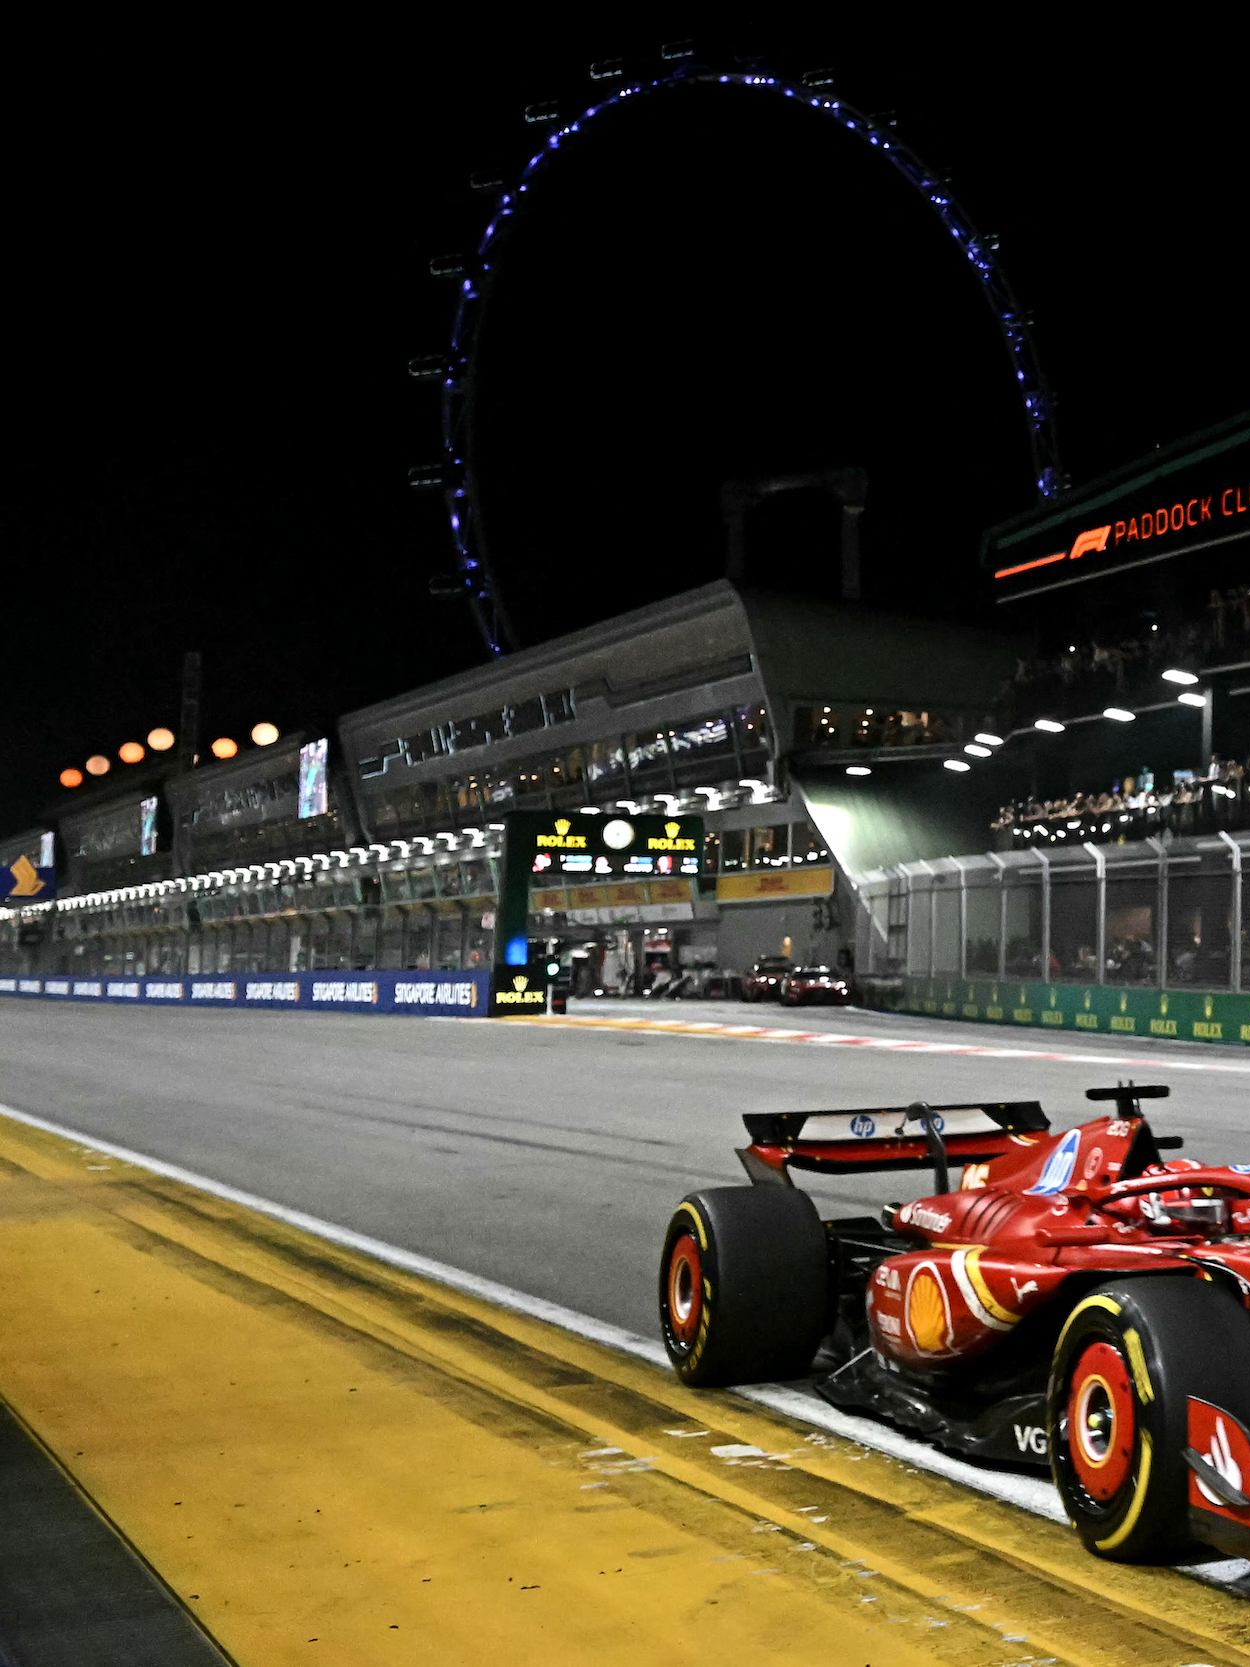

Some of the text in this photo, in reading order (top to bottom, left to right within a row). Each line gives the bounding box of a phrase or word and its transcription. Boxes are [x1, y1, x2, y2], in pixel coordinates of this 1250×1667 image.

[1115, 496, 1212, 546] PADDOCK
[537, 835, 587, 848] ROLEX
[648, 838, 695, 850] ROLEX
[395, 982, 471, 1005] SINGAPORE AIRLINES
[496, 992, 544, 1004] ROLEX
[1150, 1018, 1177, 1035] ROLEX
[1193, 1022, 1223, 1039] ROLEX
[854, 1115, 873, 1138] hp
